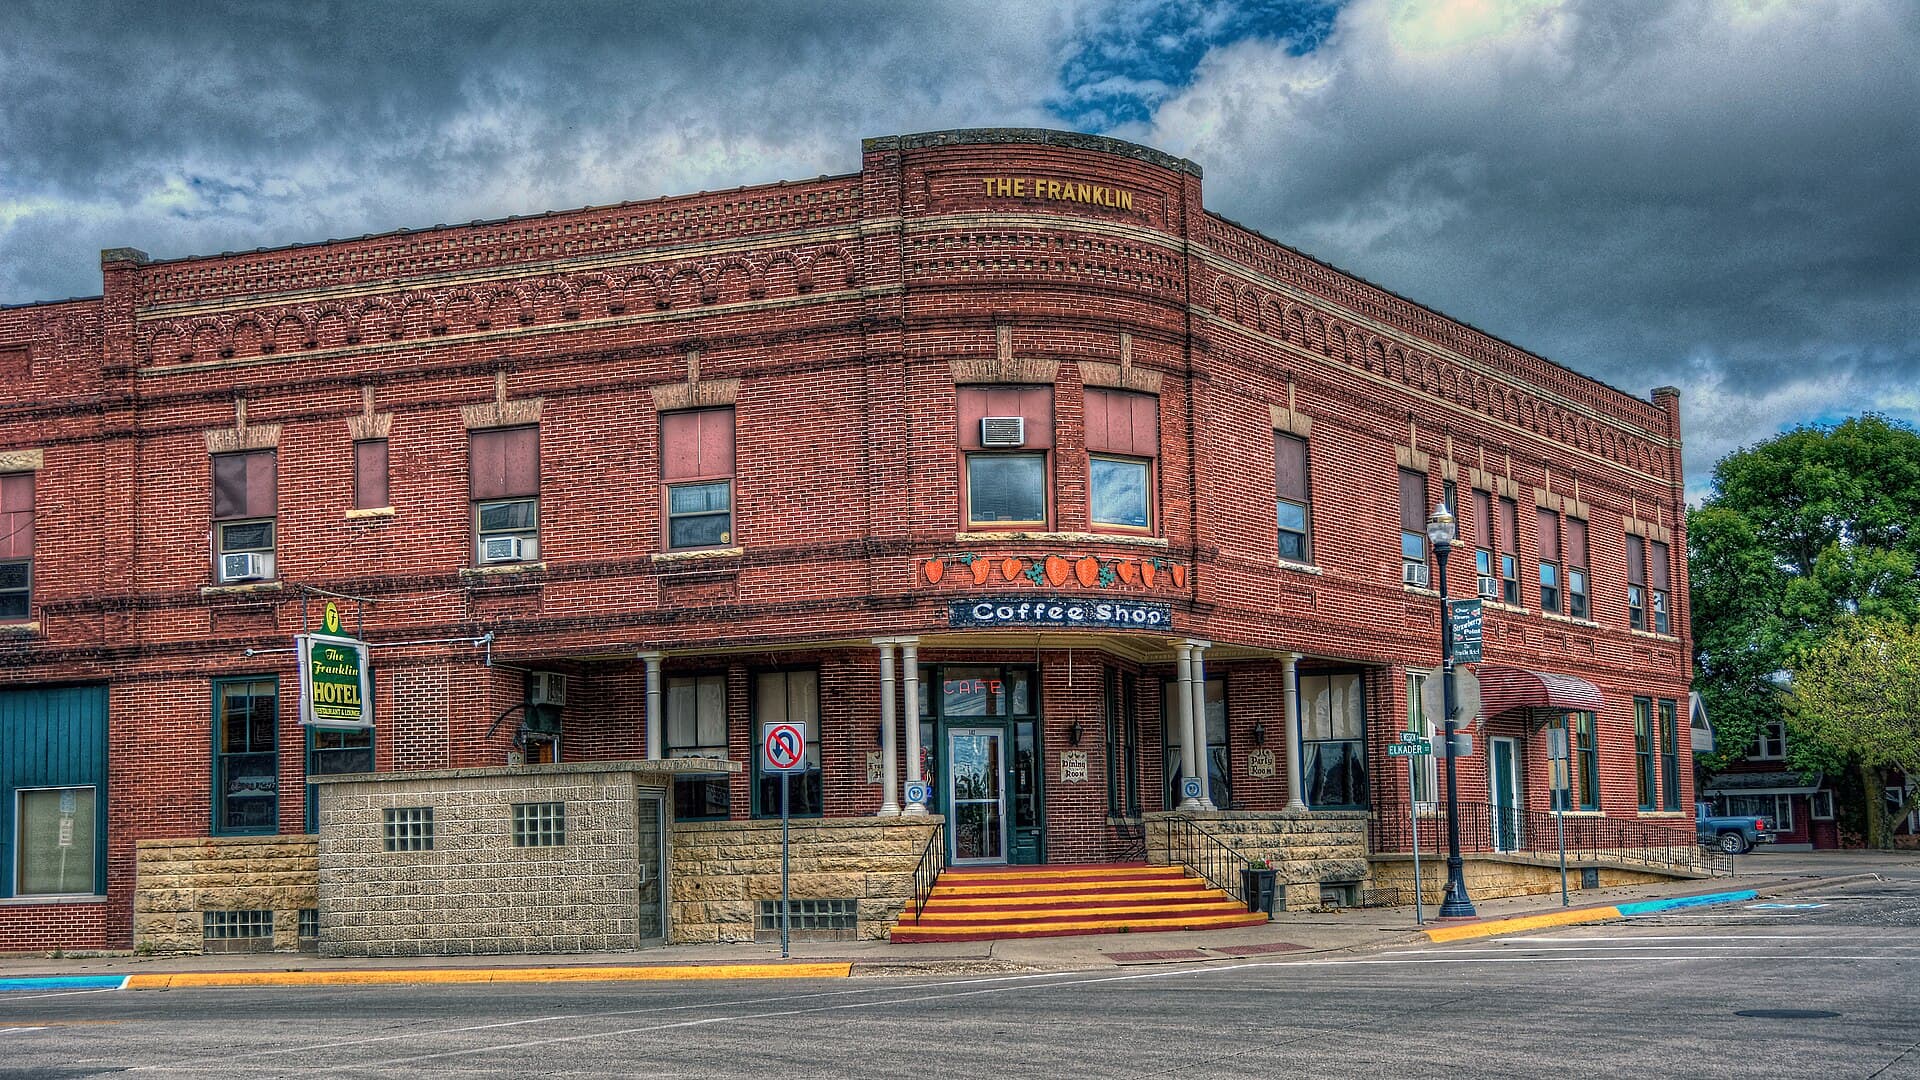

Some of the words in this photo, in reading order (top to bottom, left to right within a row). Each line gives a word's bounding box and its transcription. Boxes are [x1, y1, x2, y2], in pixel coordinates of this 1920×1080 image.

[983, 178, 1025, 197] THE
[1035, 178, 1133, 210] FRANKLIN
[972, 603, 1084, 620] Coffee
[1096, 604, 1162, 625] Shop
[325, 648, 345, 661] The
[313, 661, 359, 676] Franklin
[313, 681, 361, 705] HOTEL
[943, 679, 1003, 695] CAFE
[1390, 744, 1423, 755] ELKADER
[1062, 759, 1086, 769] Dining
[1250, 756, 1273, 765] Party
[1065, 769, 1085, 778] Room
[1251, 765, 1272, 775] Room
